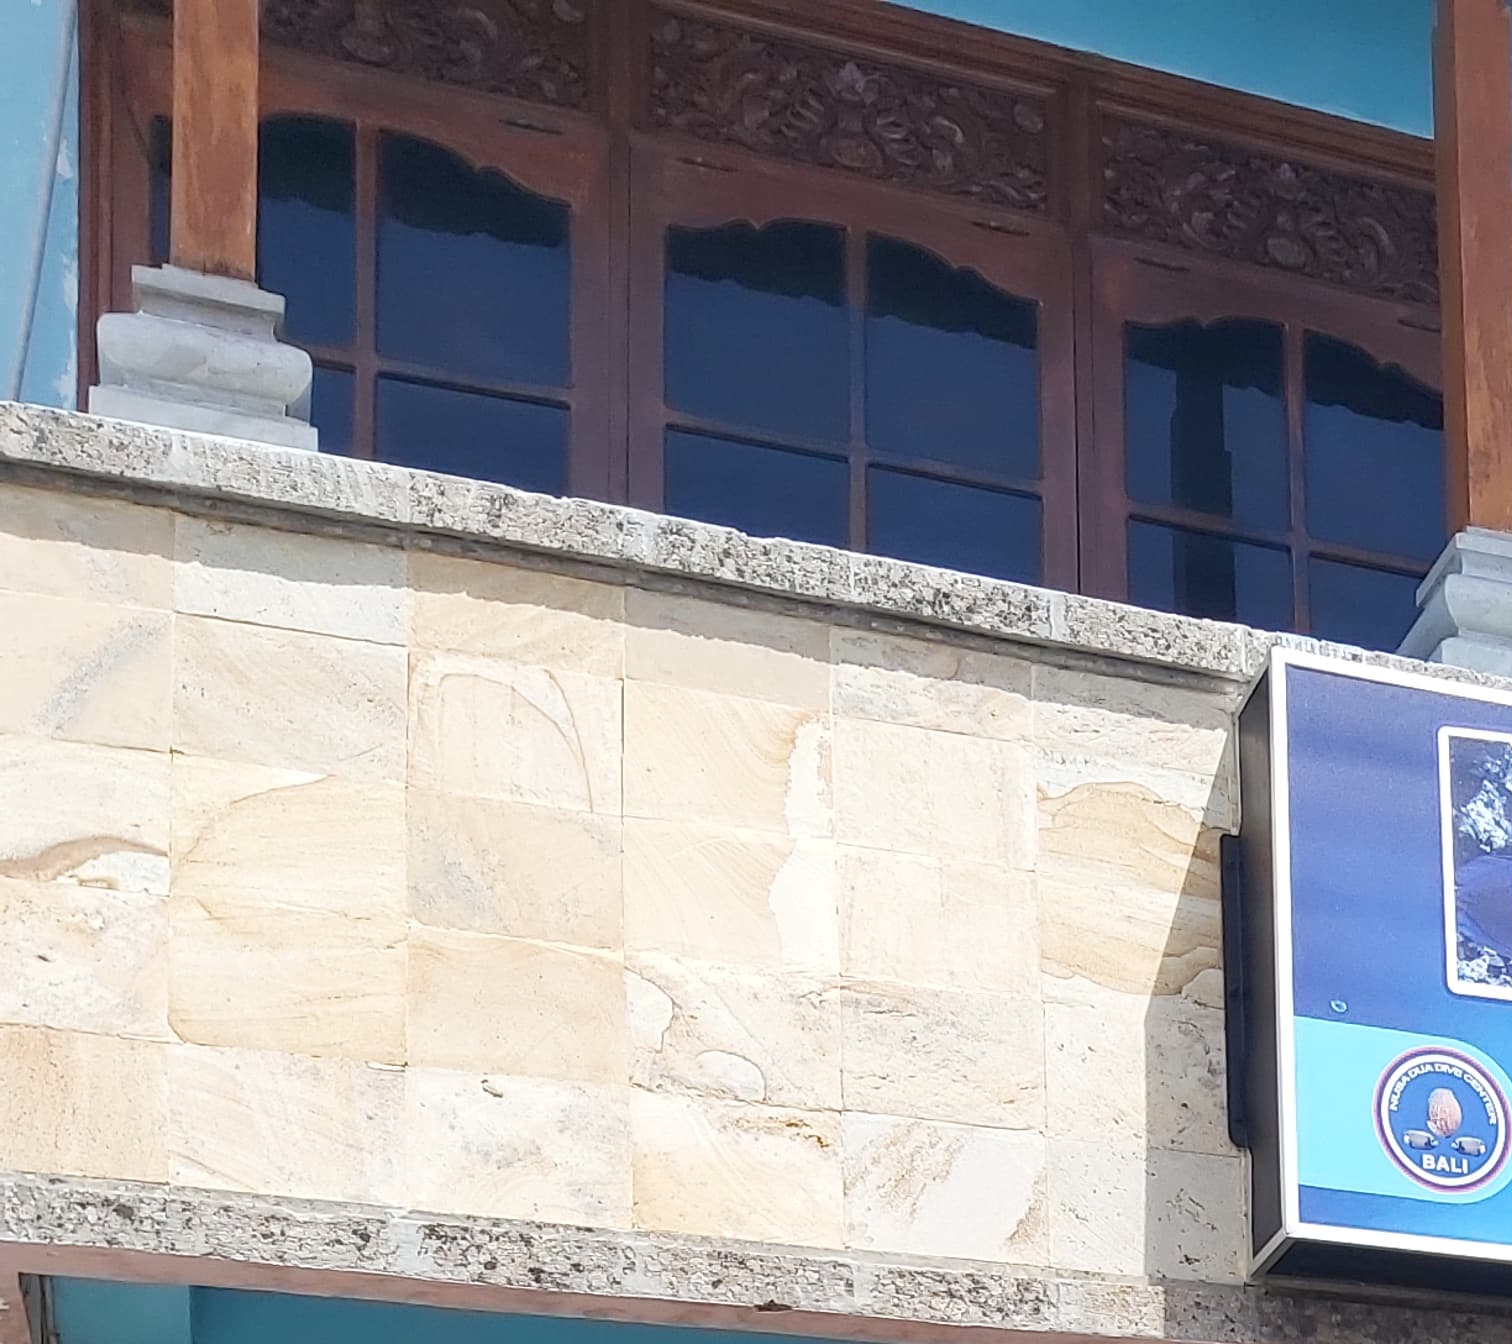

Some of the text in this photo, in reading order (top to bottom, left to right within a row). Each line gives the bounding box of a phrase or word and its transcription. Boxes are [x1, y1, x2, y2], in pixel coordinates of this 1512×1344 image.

[1389, 1062, 1498, 1126] NUSA DUA DIVE CENTER
[1421, 1153, 1470, 1175] BALI
